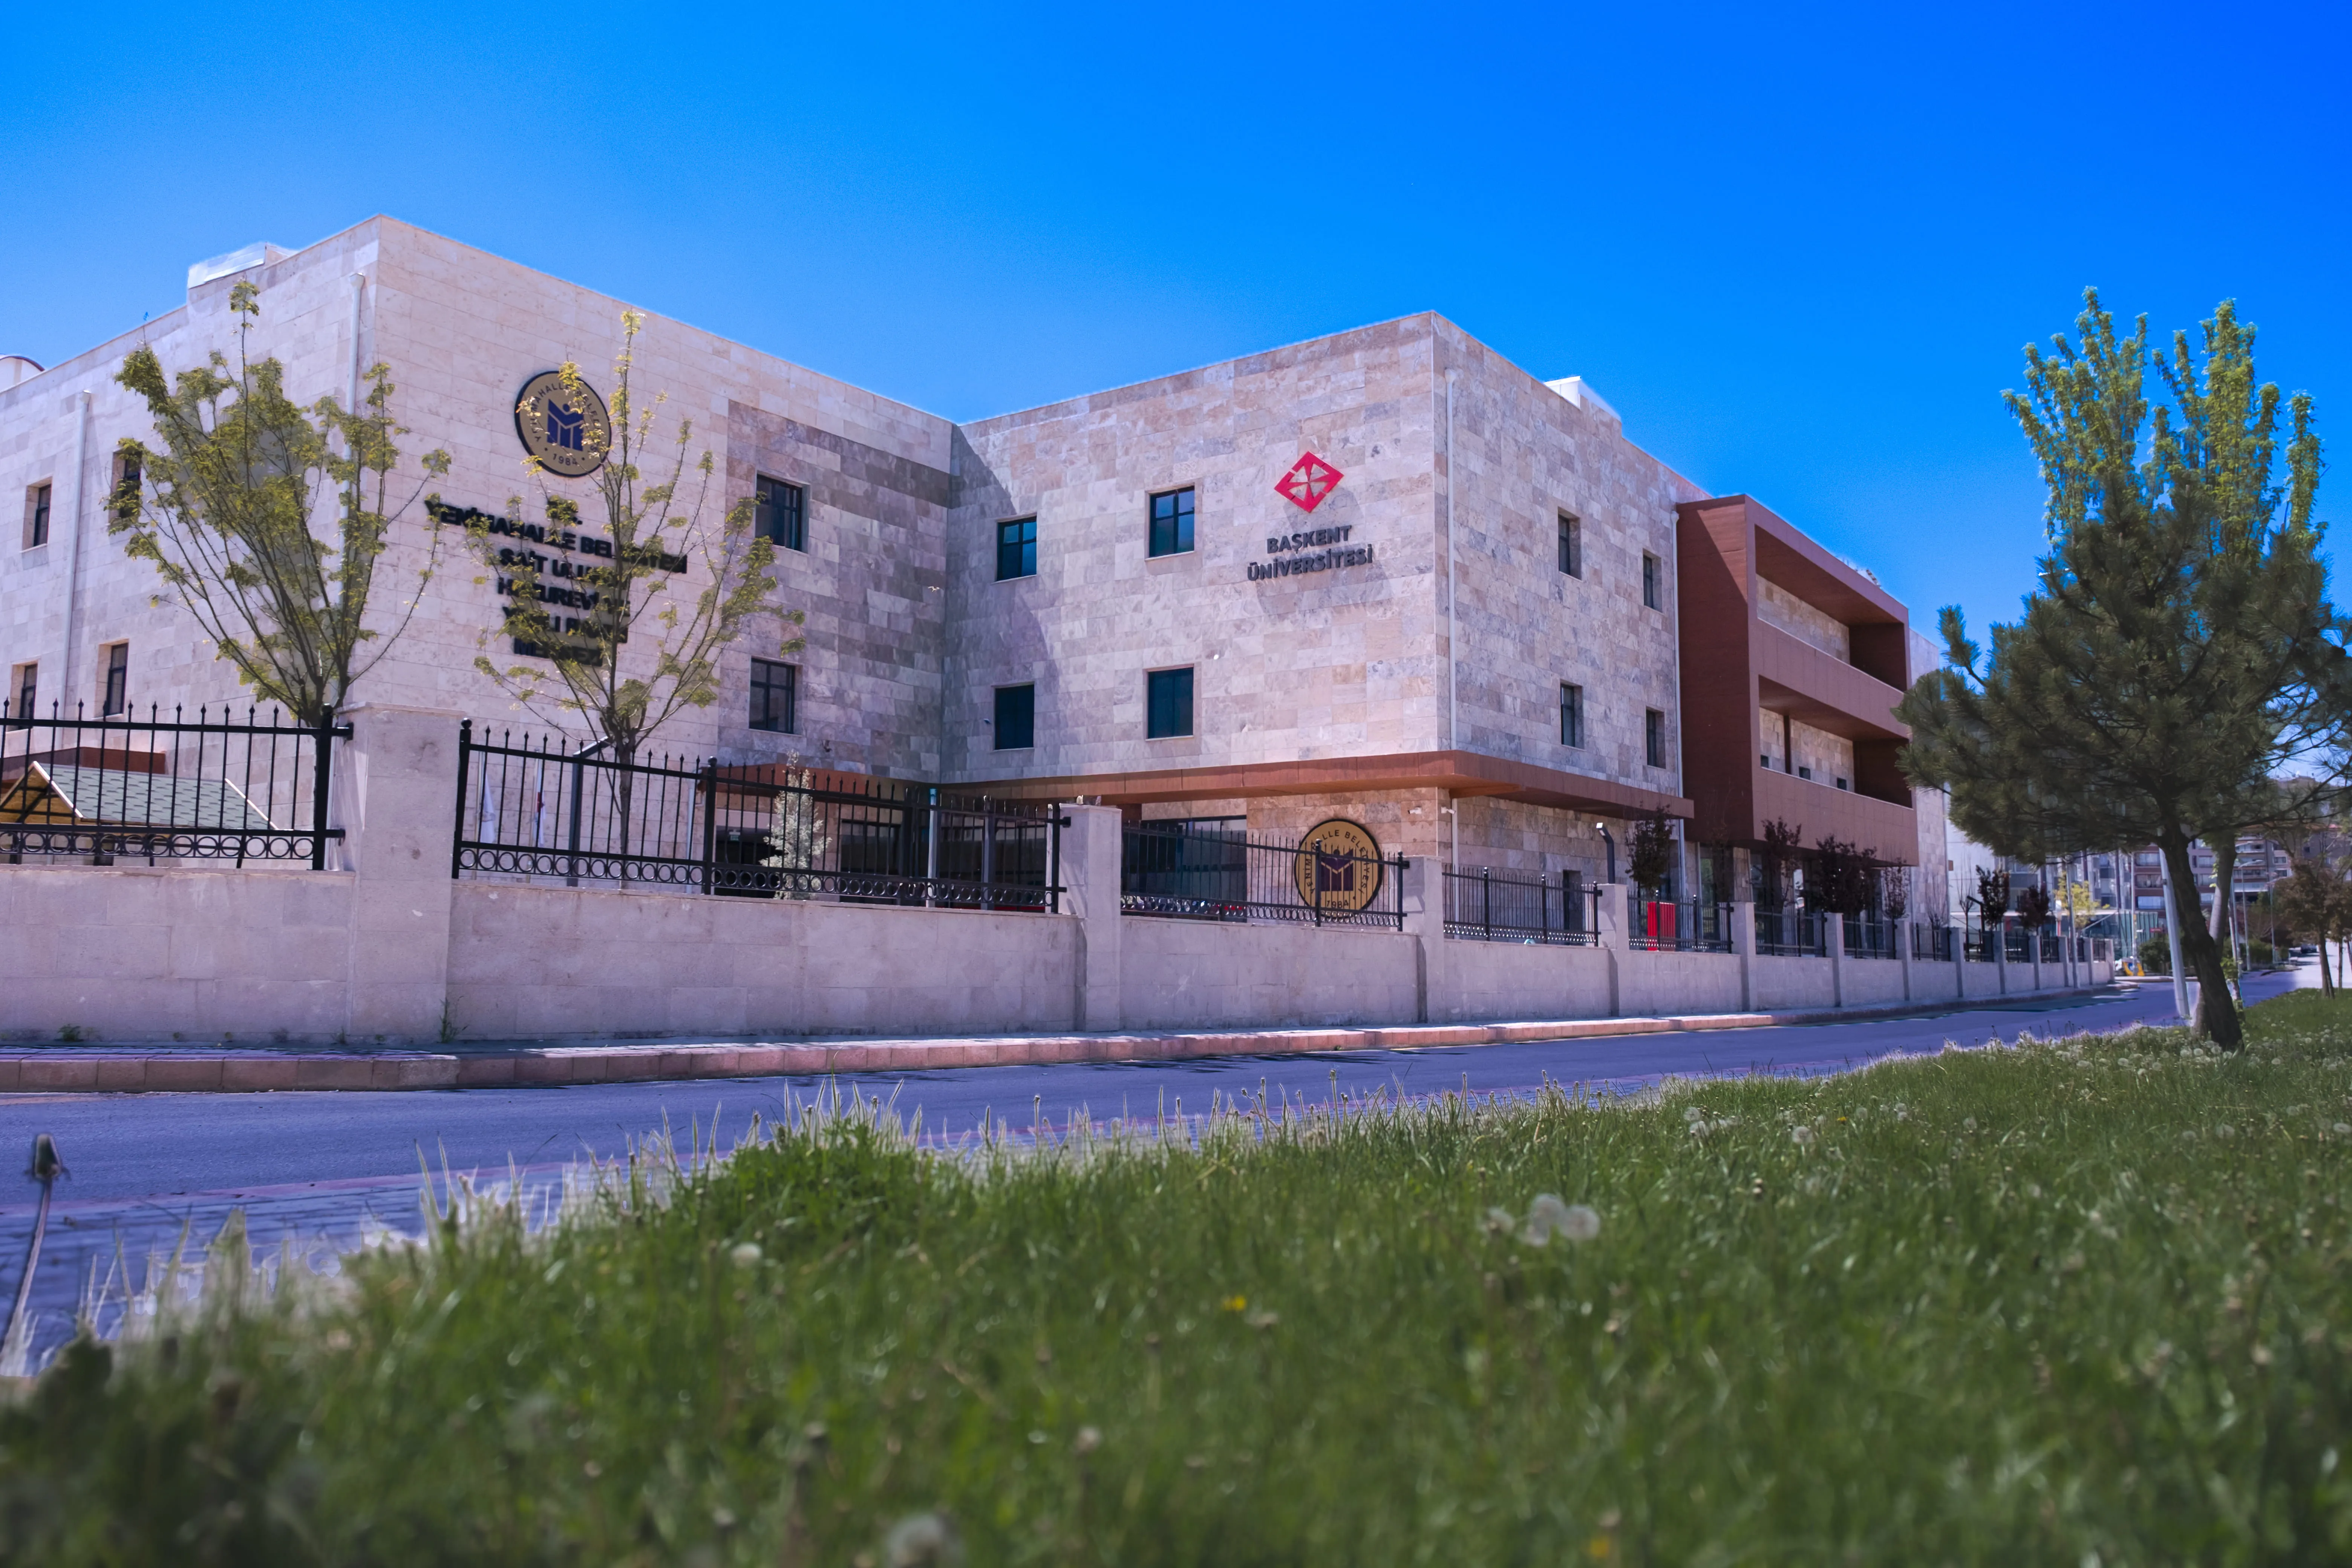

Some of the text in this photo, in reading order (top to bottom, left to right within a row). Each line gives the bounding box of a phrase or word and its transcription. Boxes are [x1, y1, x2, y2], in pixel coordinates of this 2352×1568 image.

[530, 382, 572, 442] YENMAHALL
[552, 453, 578, 466] 1984
[581, 536, 688, 574] BELDYESİ
[1267, 525, 1352, 554] BAŞKENT
[1247, 544, 1373, 581] ÜNİVERSİTESİ
[498, 577, 599, 611] HZUREVİ
[1304, 830, 1340, 894] YENİMLLE
[1326, 899, 1349, 908] 1984
